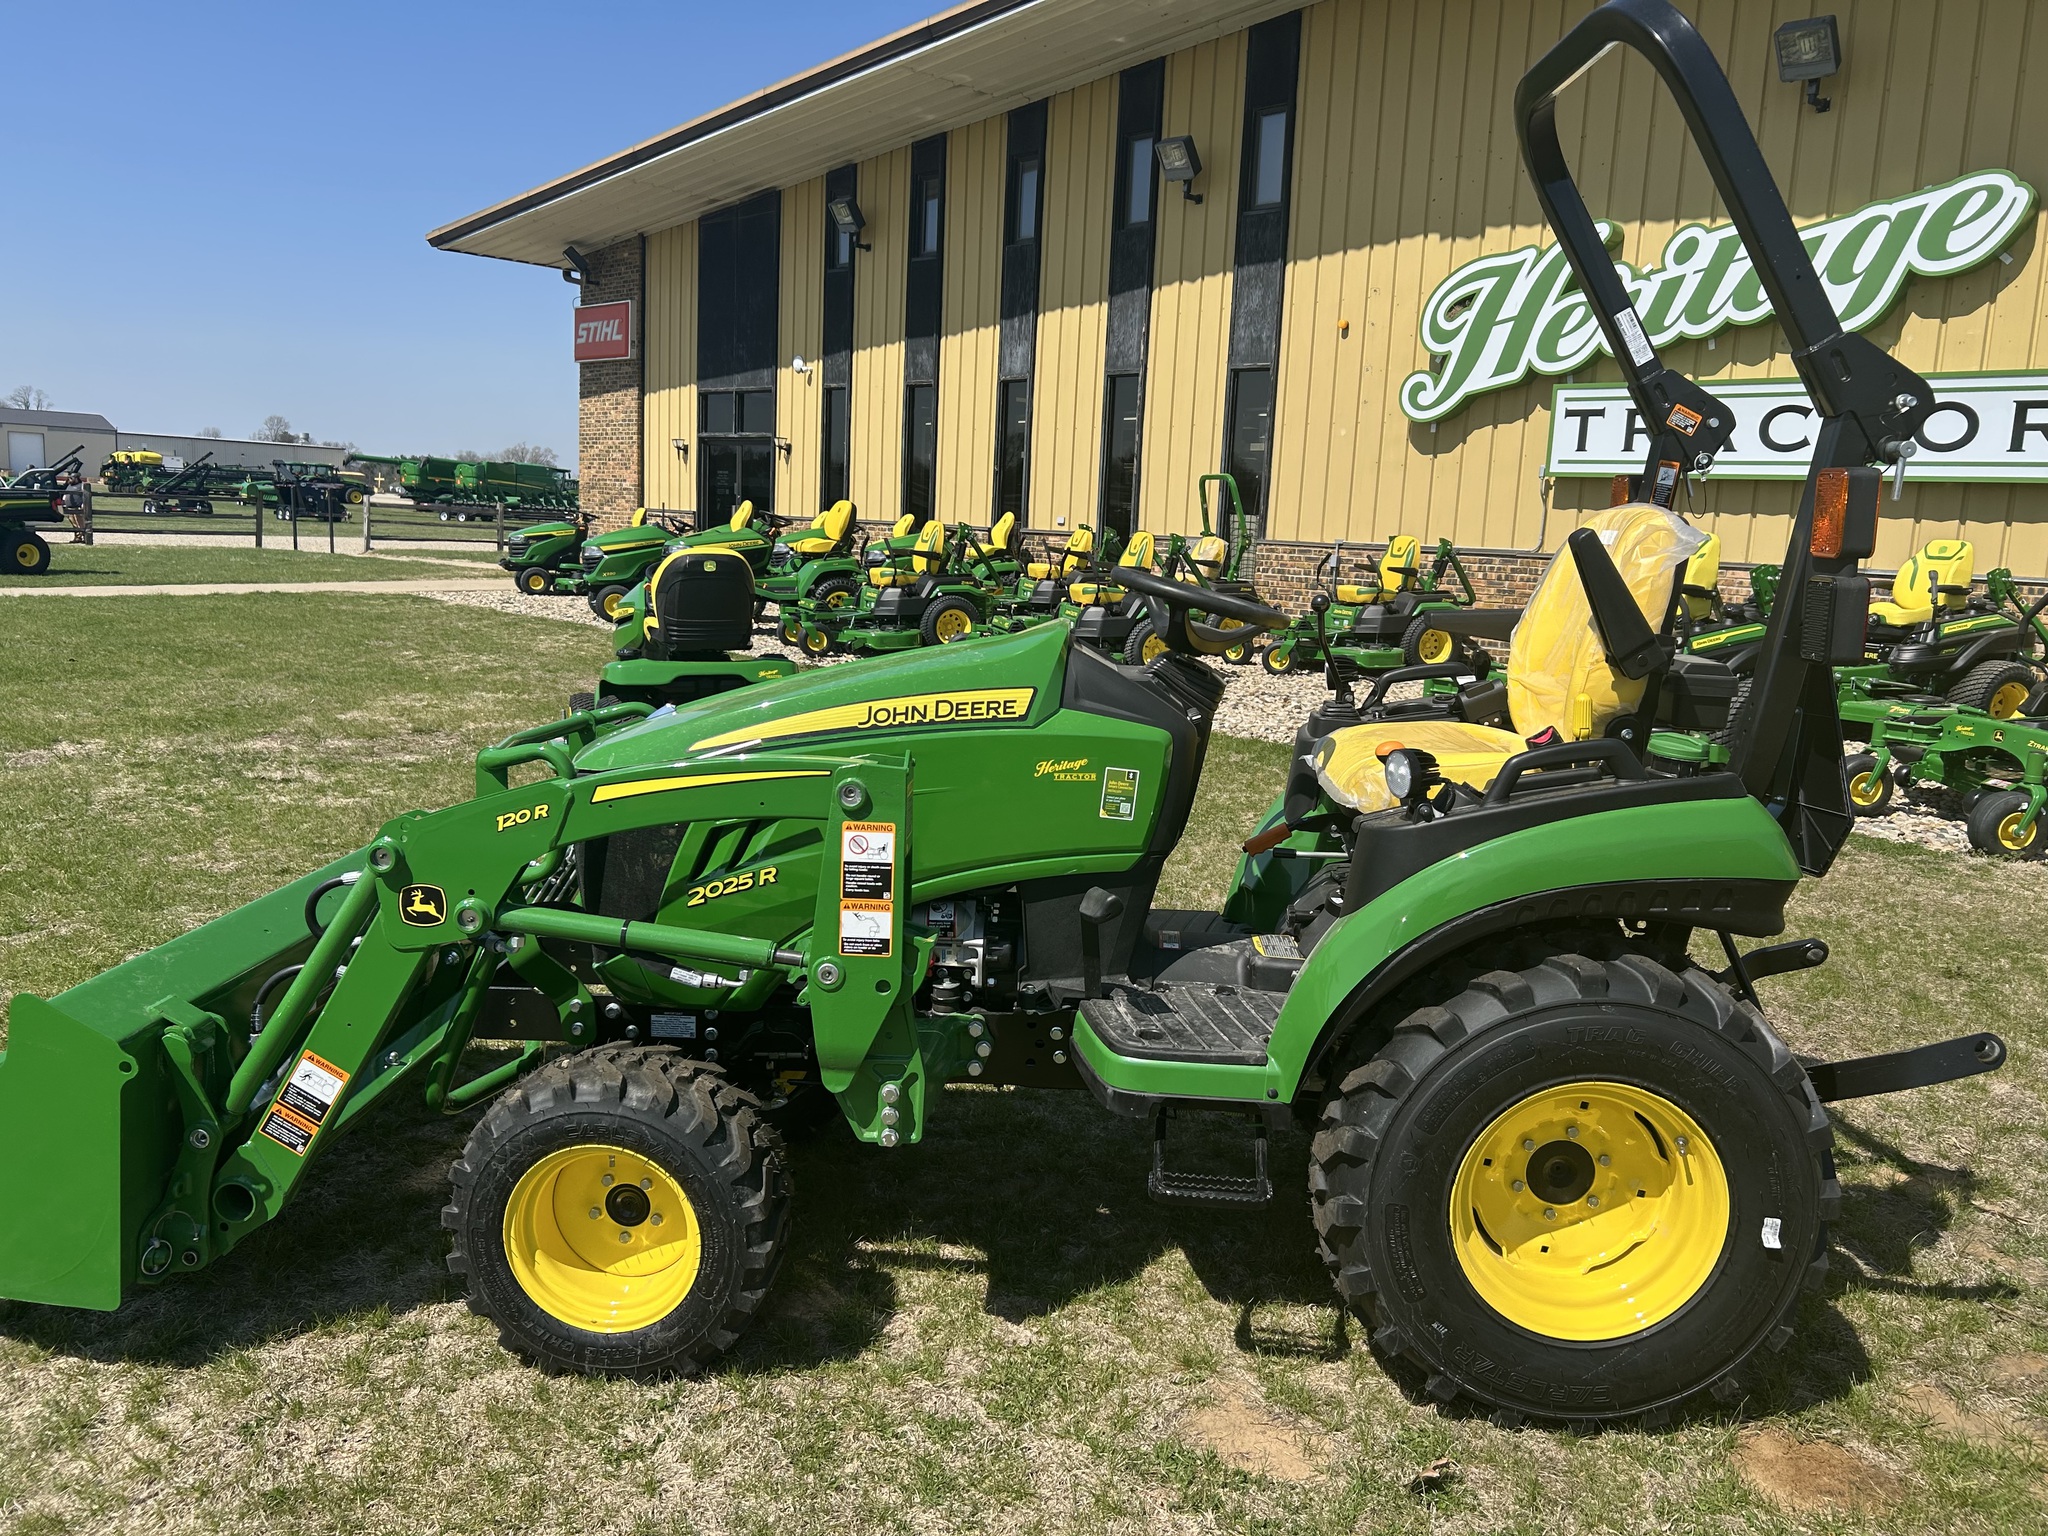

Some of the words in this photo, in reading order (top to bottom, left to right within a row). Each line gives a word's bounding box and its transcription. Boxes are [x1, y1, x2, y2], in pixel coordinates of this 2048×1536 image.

[1402, 170, 2034, 420] Heitge
[576, 319, 623, 345] STIHL
[1565, 394, 2048, 453] TRCOR
[1864, 651, 1879, 660] ERE
[857, 705, 928, 726] JOHN
[935, 699, 1018, 719] DEERE
[1034, 758, 1088, 777] Heritage
[1054, 773, 1097, 781] TRACTOR
[853, 824, 893, 832] WARNING
[851, 903, 890, 911] WARNING
[315, 1058, 344, 1078] WARNING
[284, 1112, 313, 1132] WARNING
